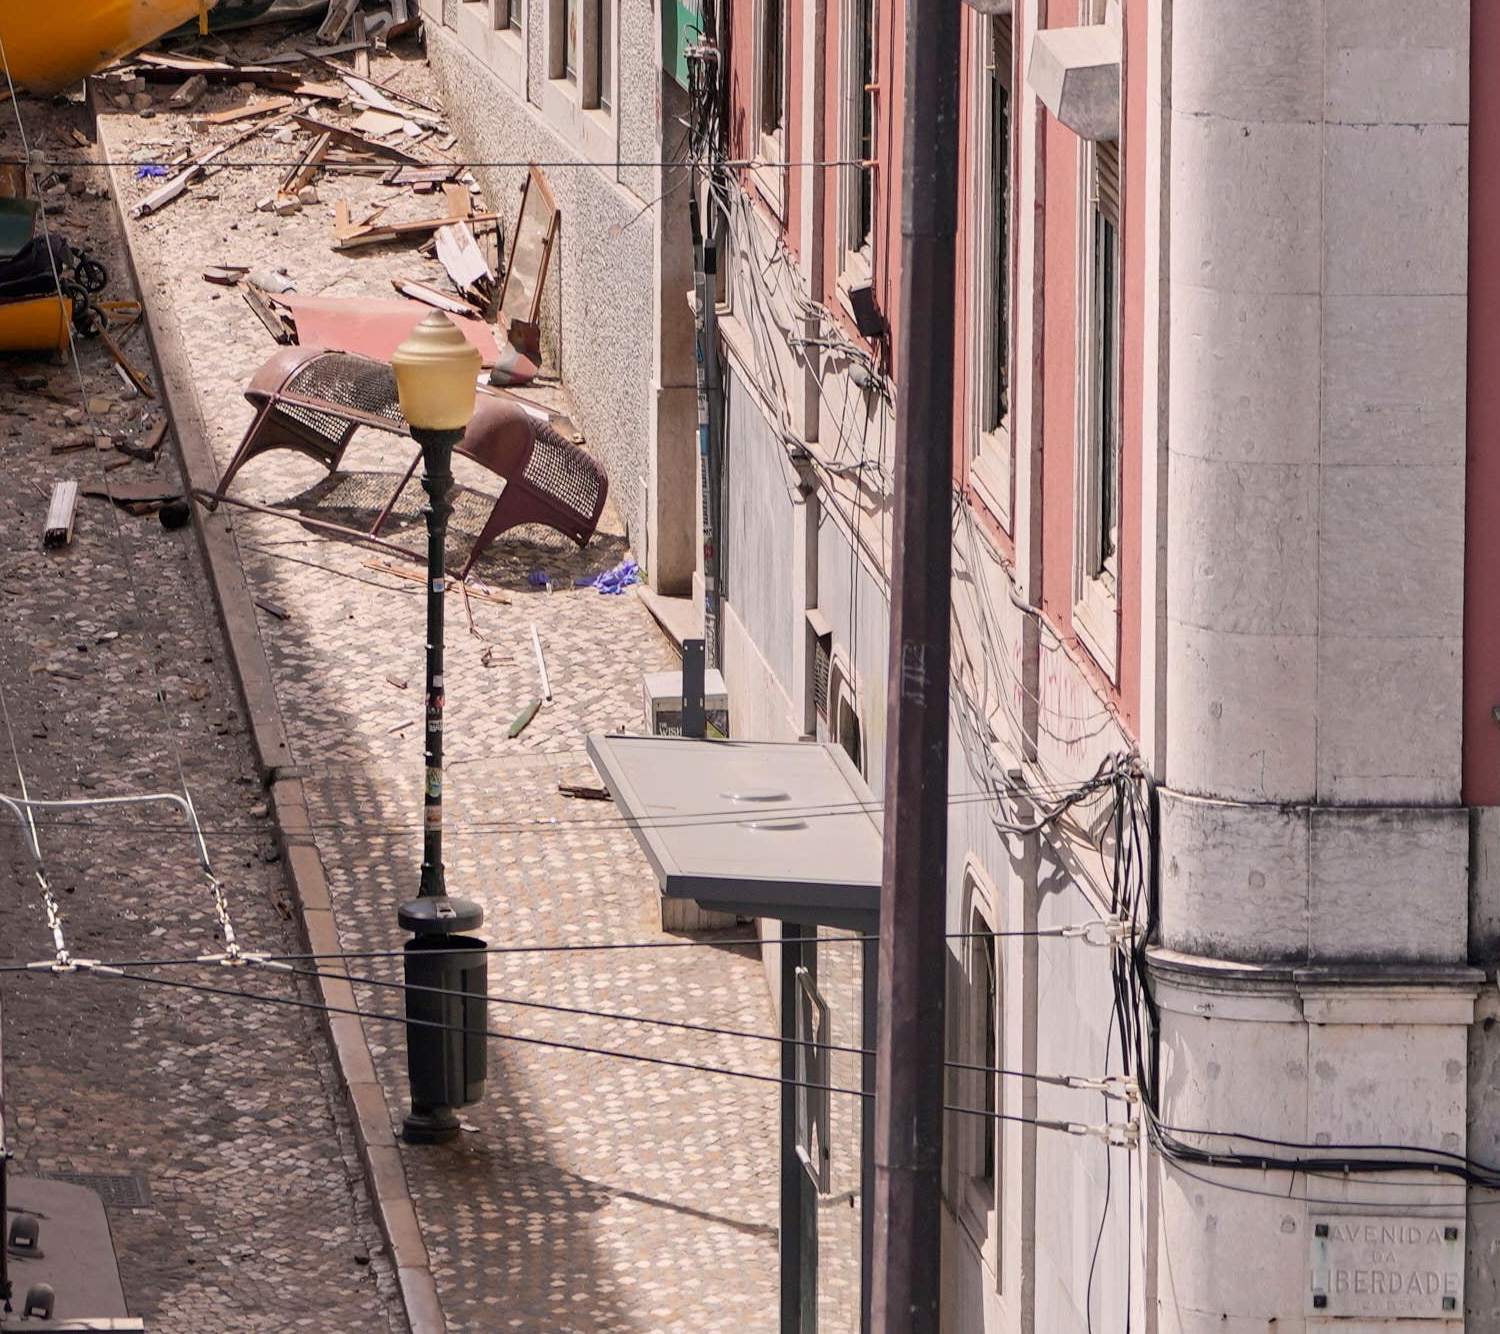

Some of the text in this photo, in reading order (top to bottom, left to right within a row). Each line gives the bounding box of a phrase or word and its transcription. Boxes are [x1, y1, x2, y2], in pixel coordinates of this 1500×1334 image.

[1330, 1224, 1443, 1245] AVENIDA
[1372, 1249, 1397, 1264] DA
[1310, 1270, 1459, 1296] LIBERDADE
